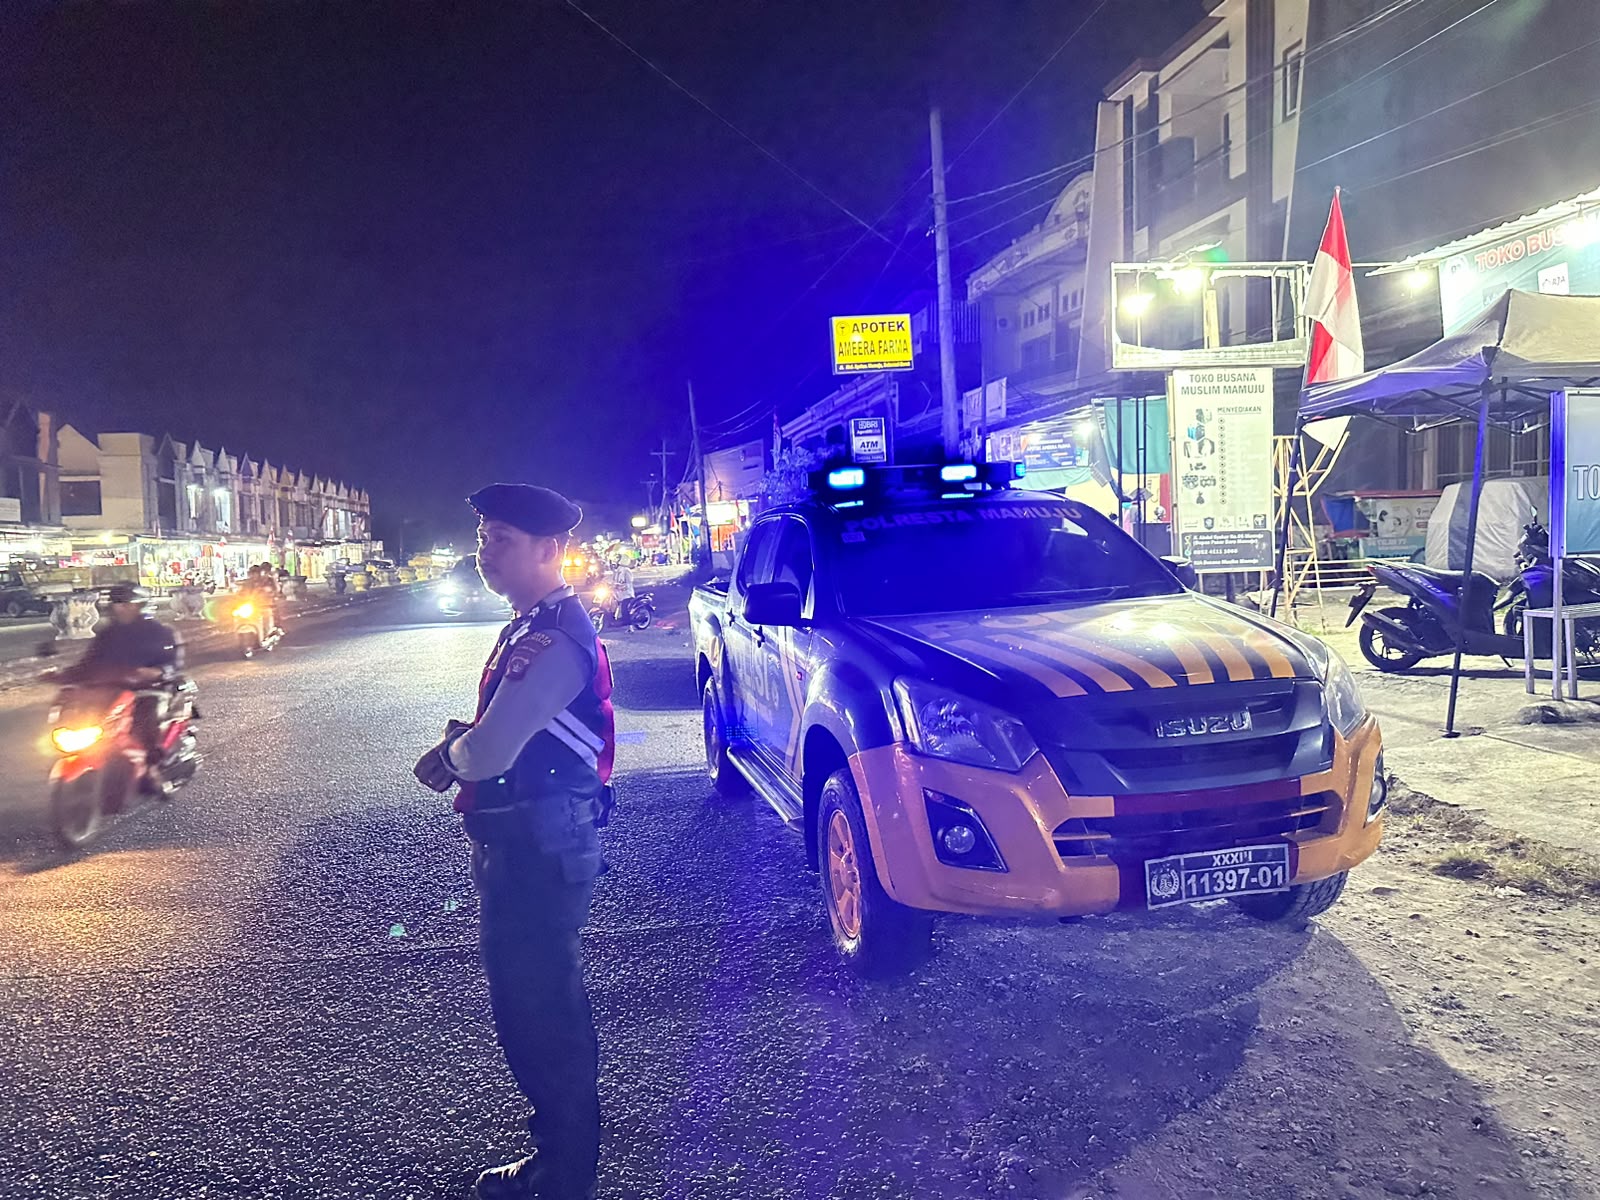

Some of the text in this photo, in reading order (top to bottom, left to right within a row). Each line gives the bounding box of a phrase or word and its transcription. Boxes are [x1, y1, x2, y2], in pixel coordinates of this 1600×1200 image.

[1475, 239, 1525, 273] TOKO
[851, 320, 906, 334] APOTEK
[838, 339, 909, 357] AMEERA FARMA
[1189, 372, 1257, 383] TOKO BUSANA
[1181, 384, 1265, 395] MUSLIM MAMUJU
[1216, 405, 1262, 413] MENYEDIAKAN
[860, 440, 879, 449] ATM
[844, 507, 1083, 532] POLRESTA MAMUJU
[1156, 707, 1253, 738] ISUZU
[1212, 850, 1252, 867] XXXIII
[1186, 866, 1284, 896] 11397-01
